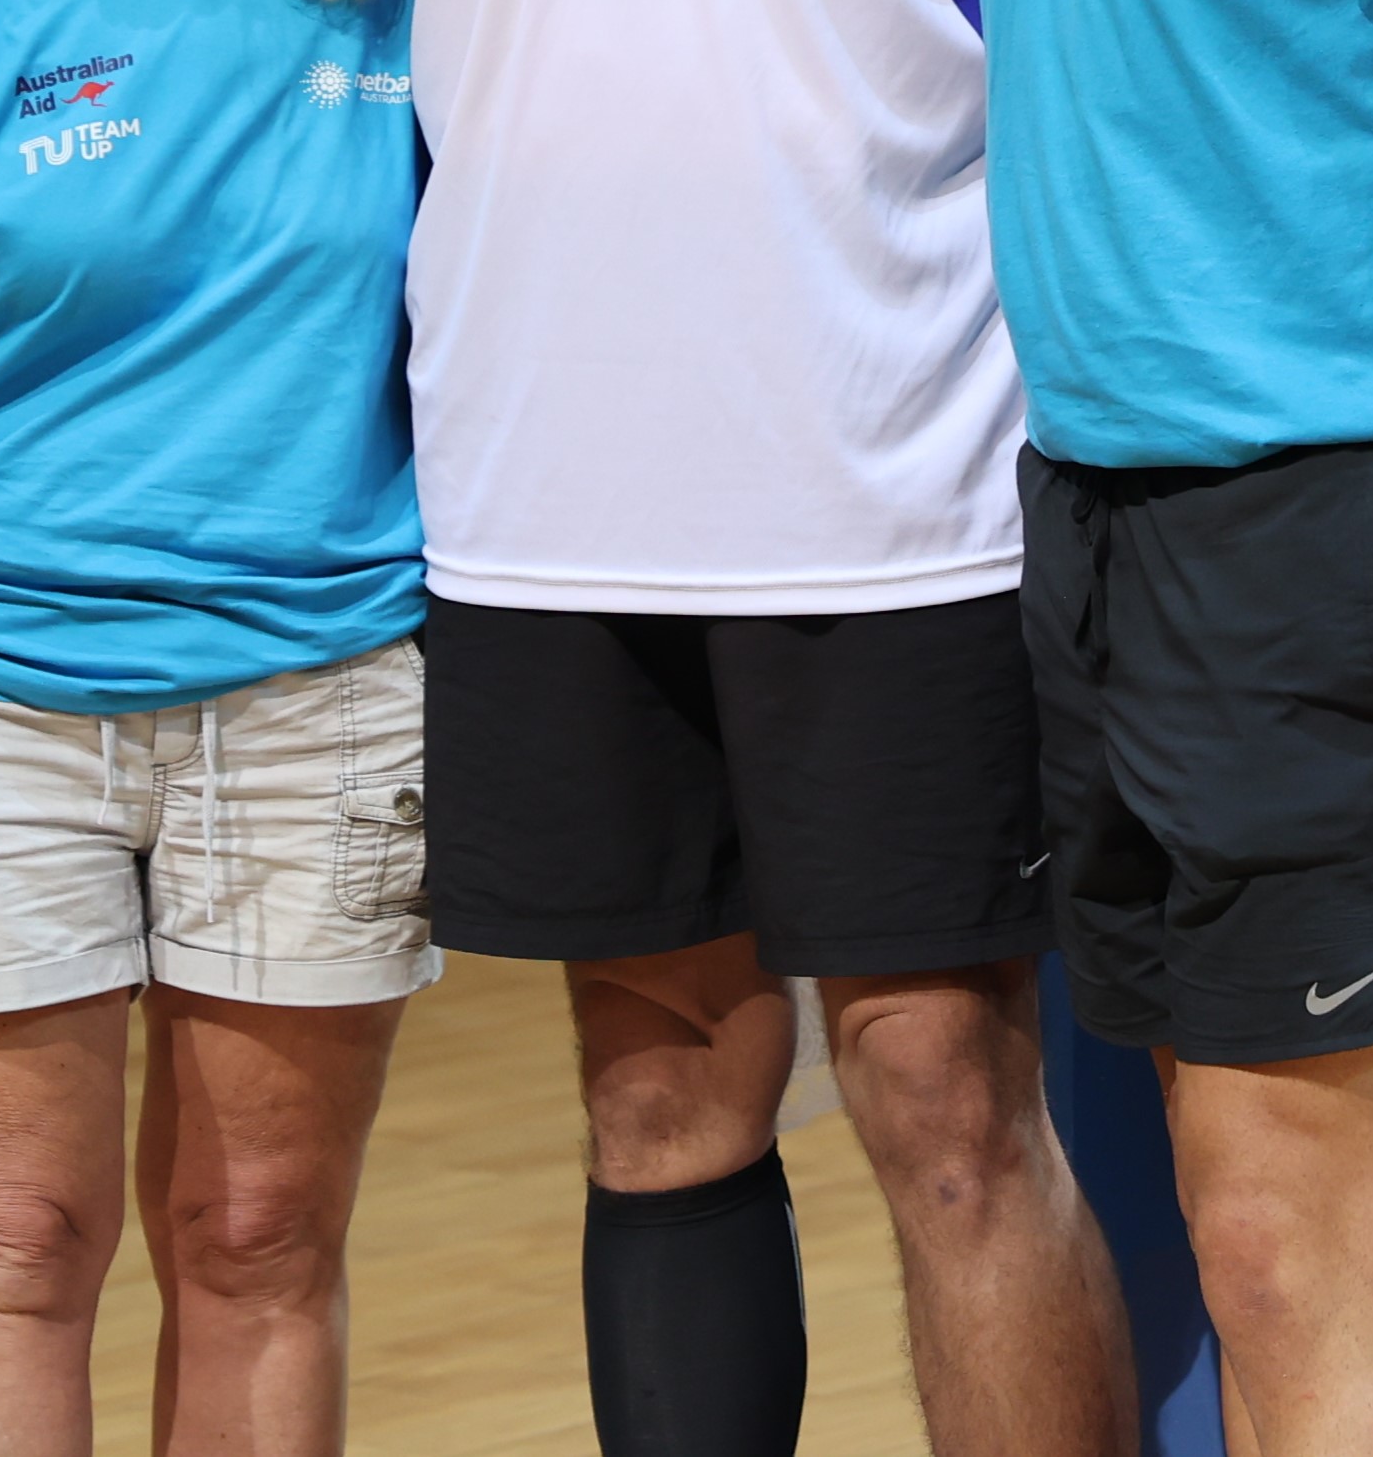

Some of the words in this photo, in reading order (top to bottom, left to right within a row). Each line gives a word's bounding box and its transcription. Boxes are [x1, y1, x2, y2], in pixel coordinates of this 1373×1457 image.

[15, 53, 134, 97] Australian
[354, 72, 411, 93] netba
[19, 91, 56, 119] Aid
[74, 117, 141, 142] TEAM
[80, 140, 113, 160] UP
